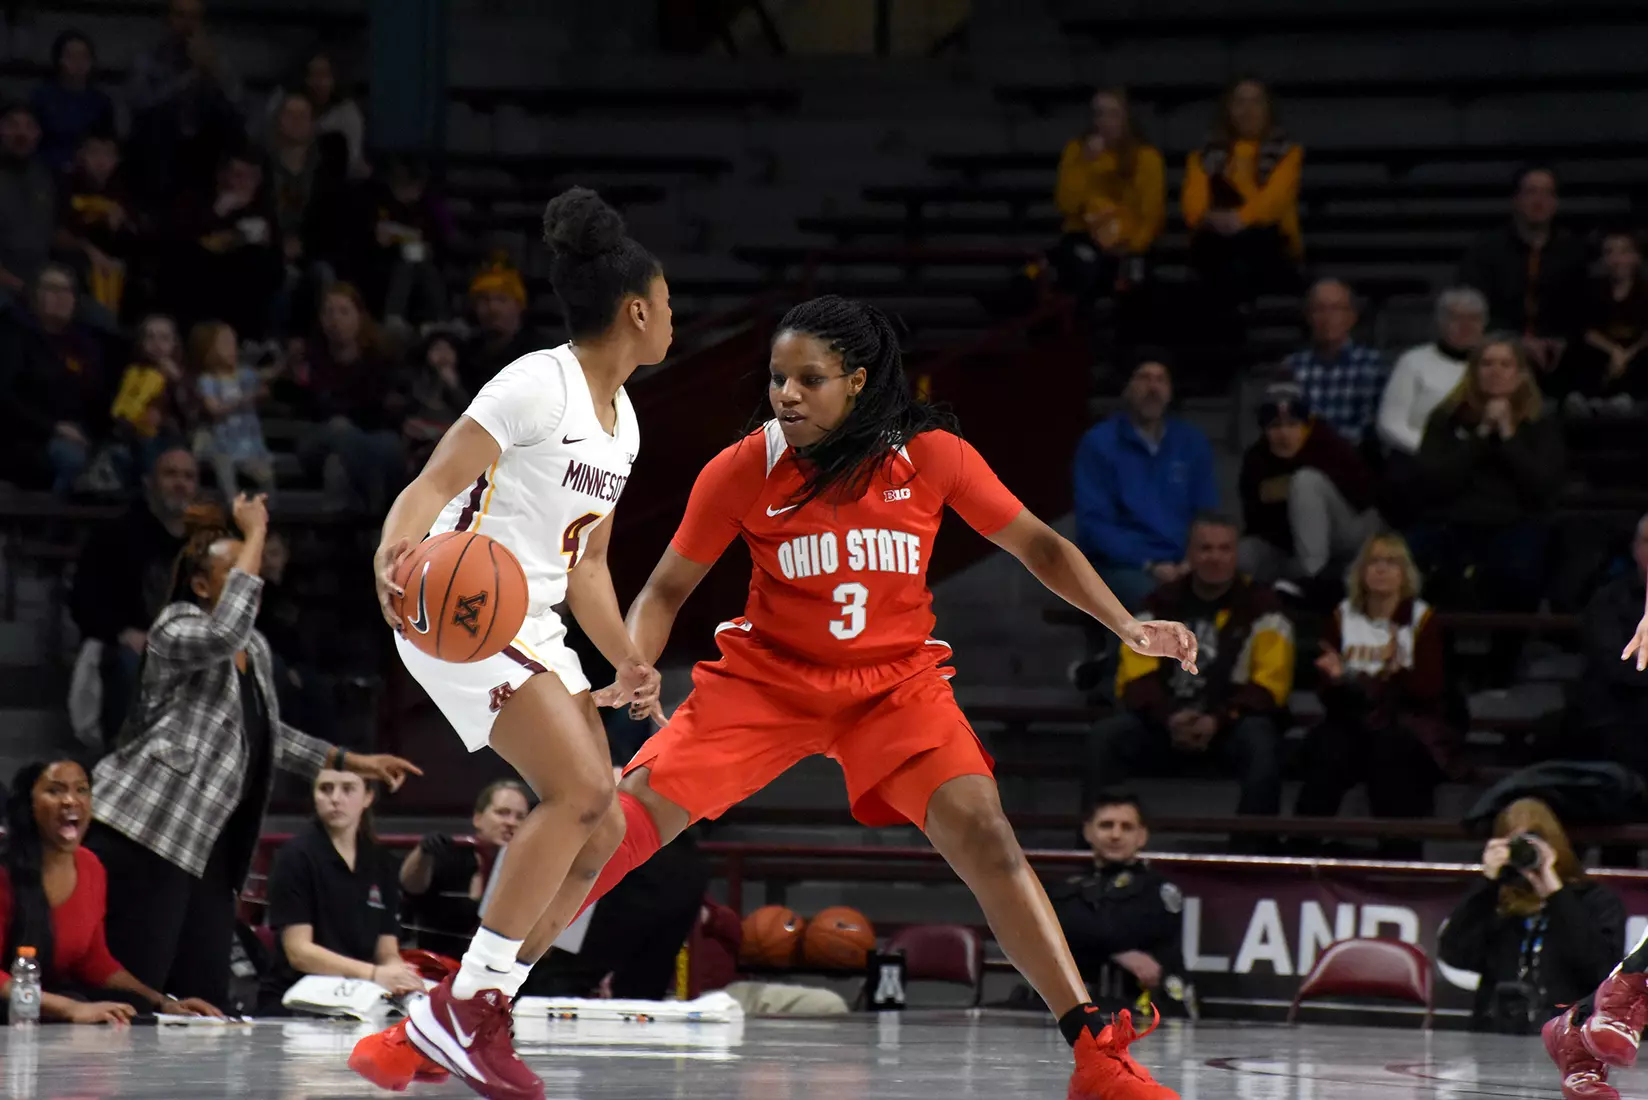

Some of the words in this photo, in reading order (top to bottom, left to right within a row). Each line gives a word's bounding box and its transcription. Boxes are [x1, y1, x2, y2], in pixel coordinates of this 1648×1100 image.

[560, 510, 603, 573] 4
[777, 531, 839, 580] OHIO
[846, 528, 920, 575] STATE
[829, 582, 869, 640] 3
